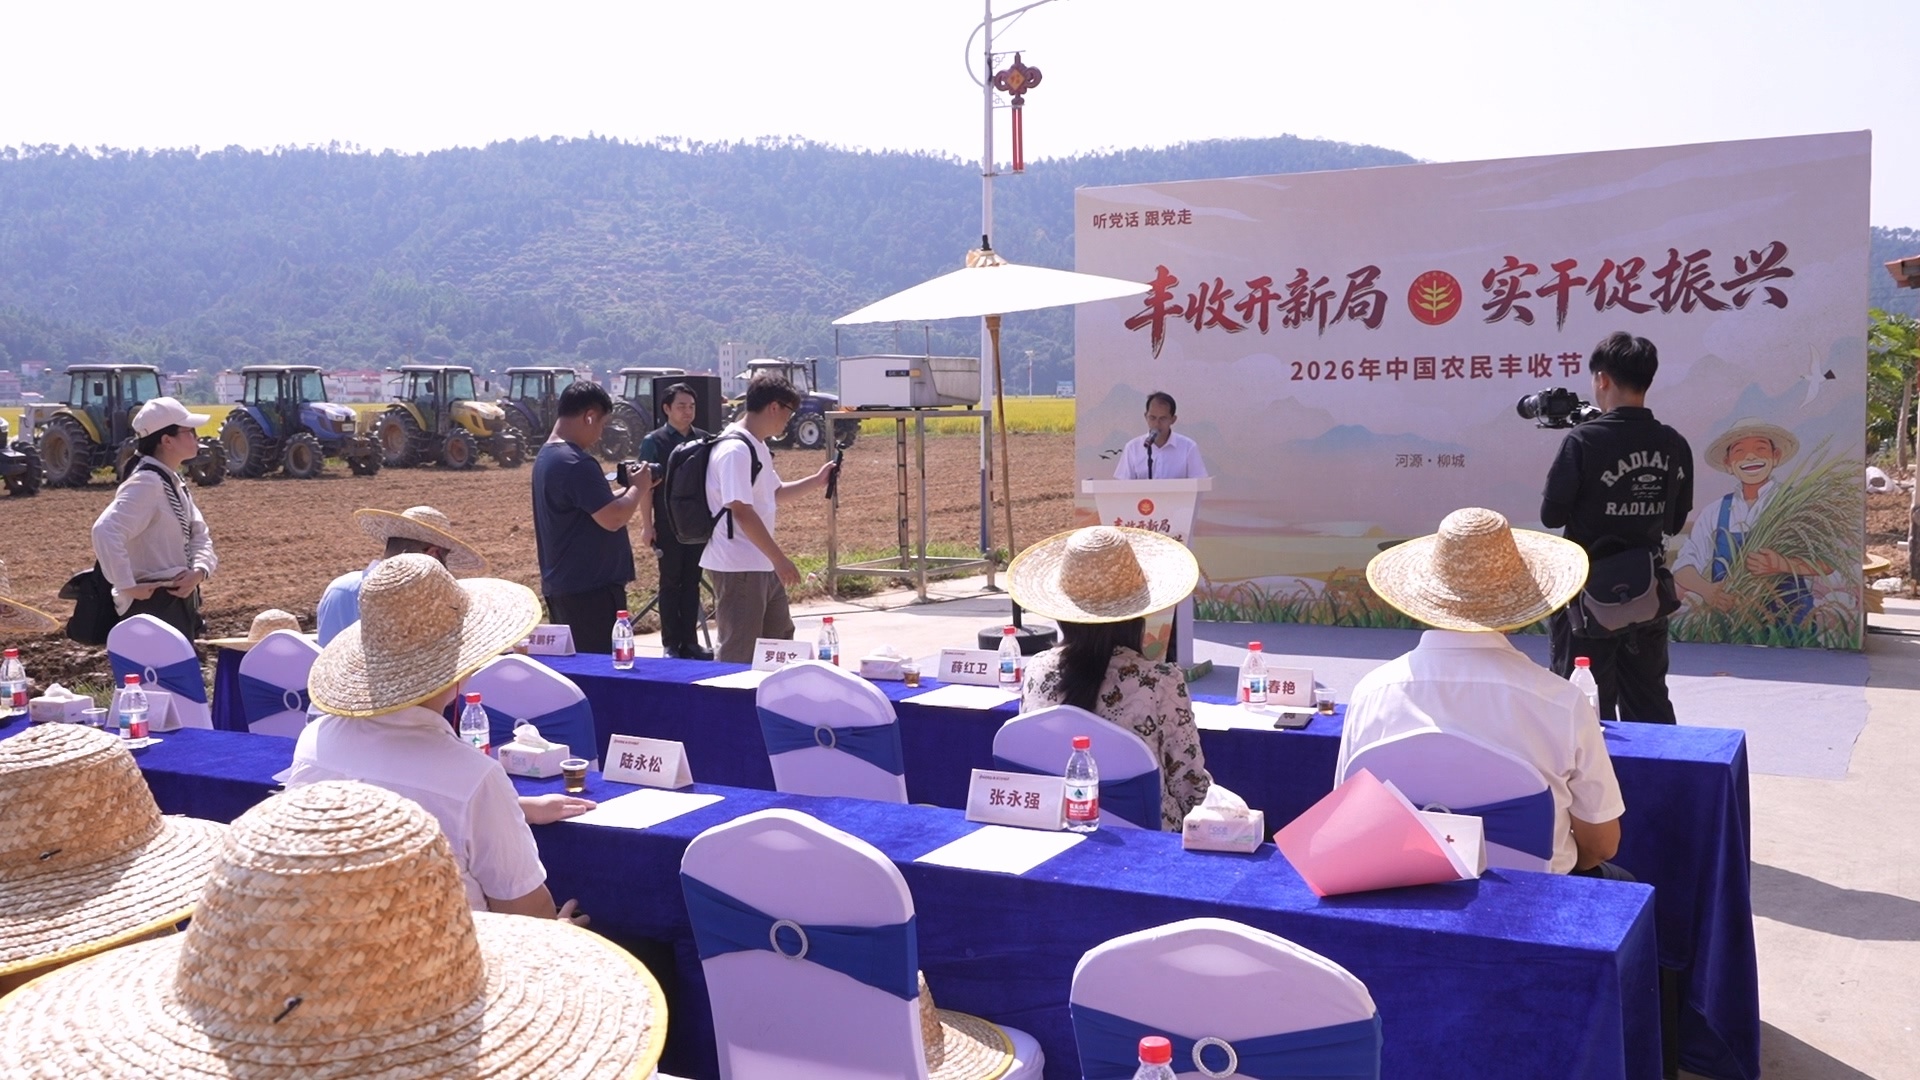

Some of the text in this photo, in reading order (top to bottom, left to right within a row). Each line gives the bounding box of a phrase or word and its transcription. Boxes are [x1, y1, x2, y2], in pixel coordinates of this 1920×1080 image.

[1093, 208, 1192, 229] 听党话 跟党走
[1124, 240, 1795, 359] 丰收开新局 实干促振兴
[1290, 352, 1583, 381] 2026年中国农民丰收节
[619, 752, 663, 773] 陆永松
[990, 788, 1040, 810] 张永强
